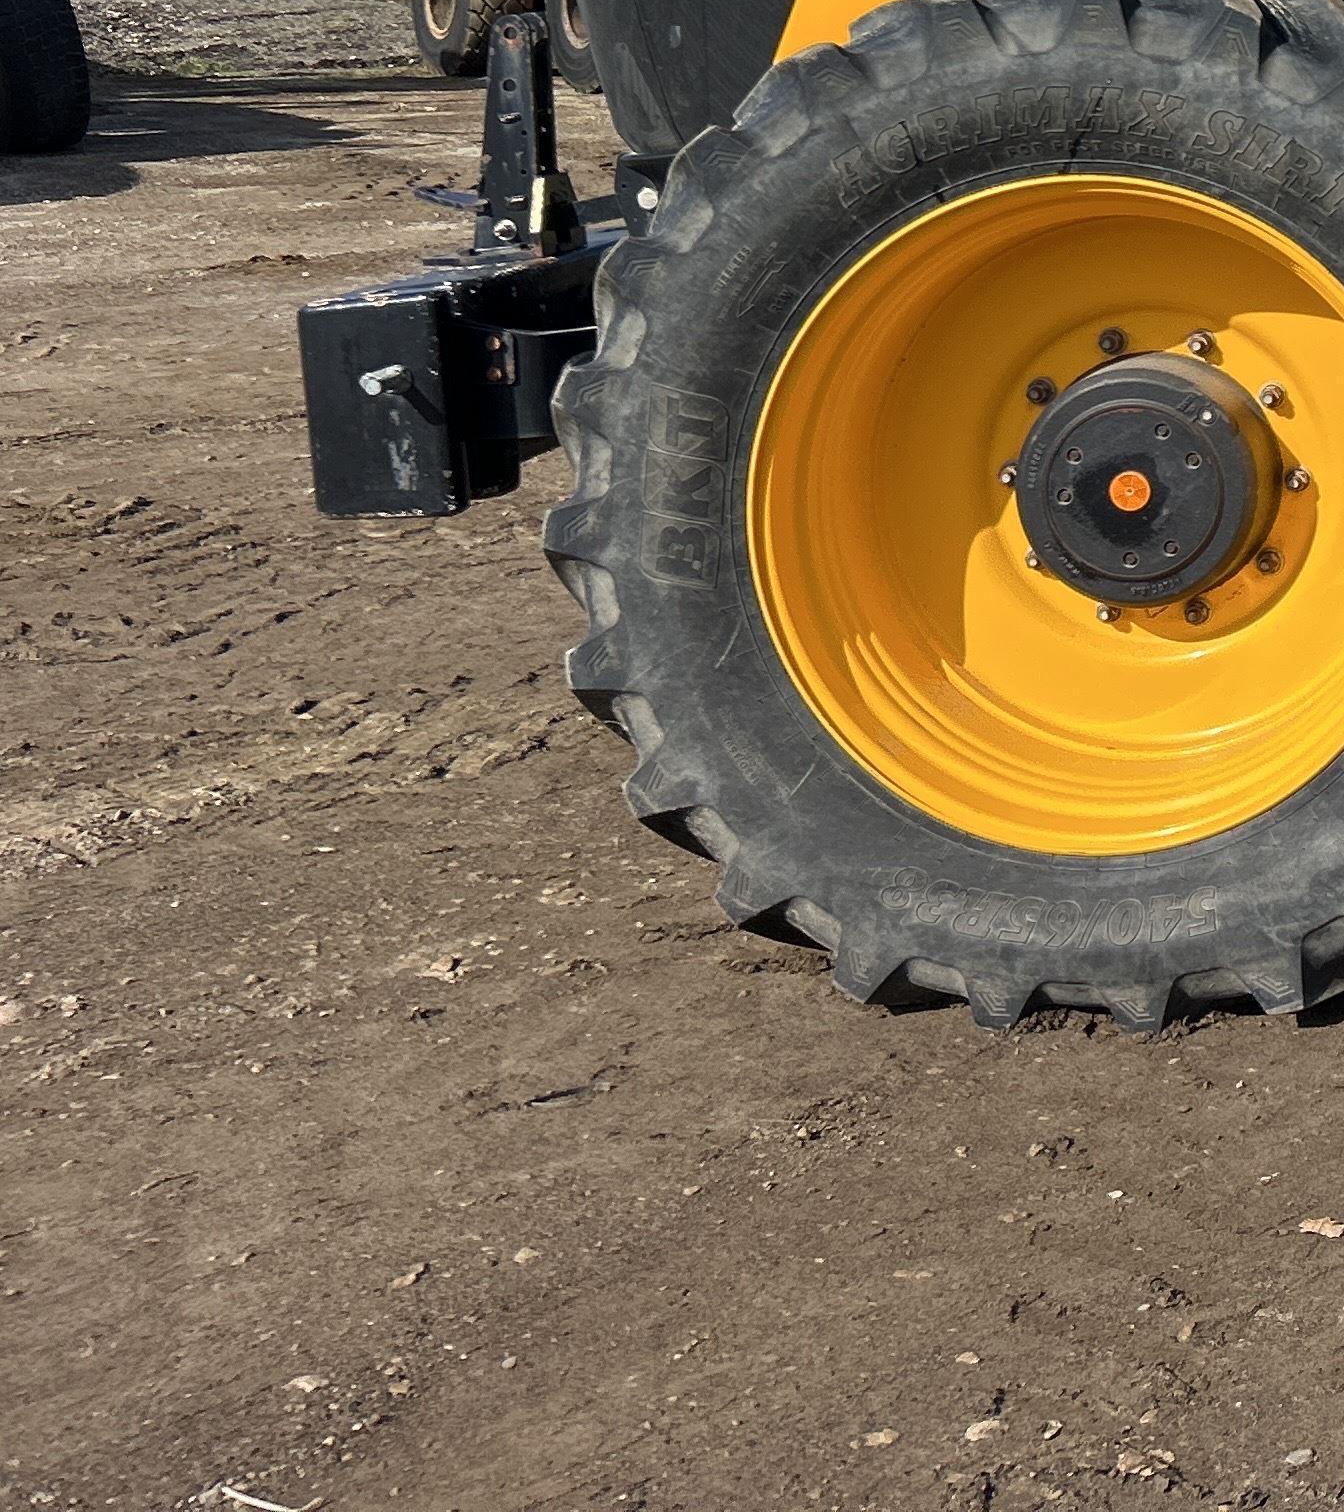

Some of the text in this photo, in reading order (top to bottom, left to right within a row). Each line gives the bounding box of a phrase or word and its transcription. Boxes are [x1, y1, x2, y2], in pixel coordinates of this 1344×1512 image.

[831, 86, 1186, 207] AGRIMAX
[652, 393, 718, 582] BKT
[880, 865, 1217, 950] 540/65R38
